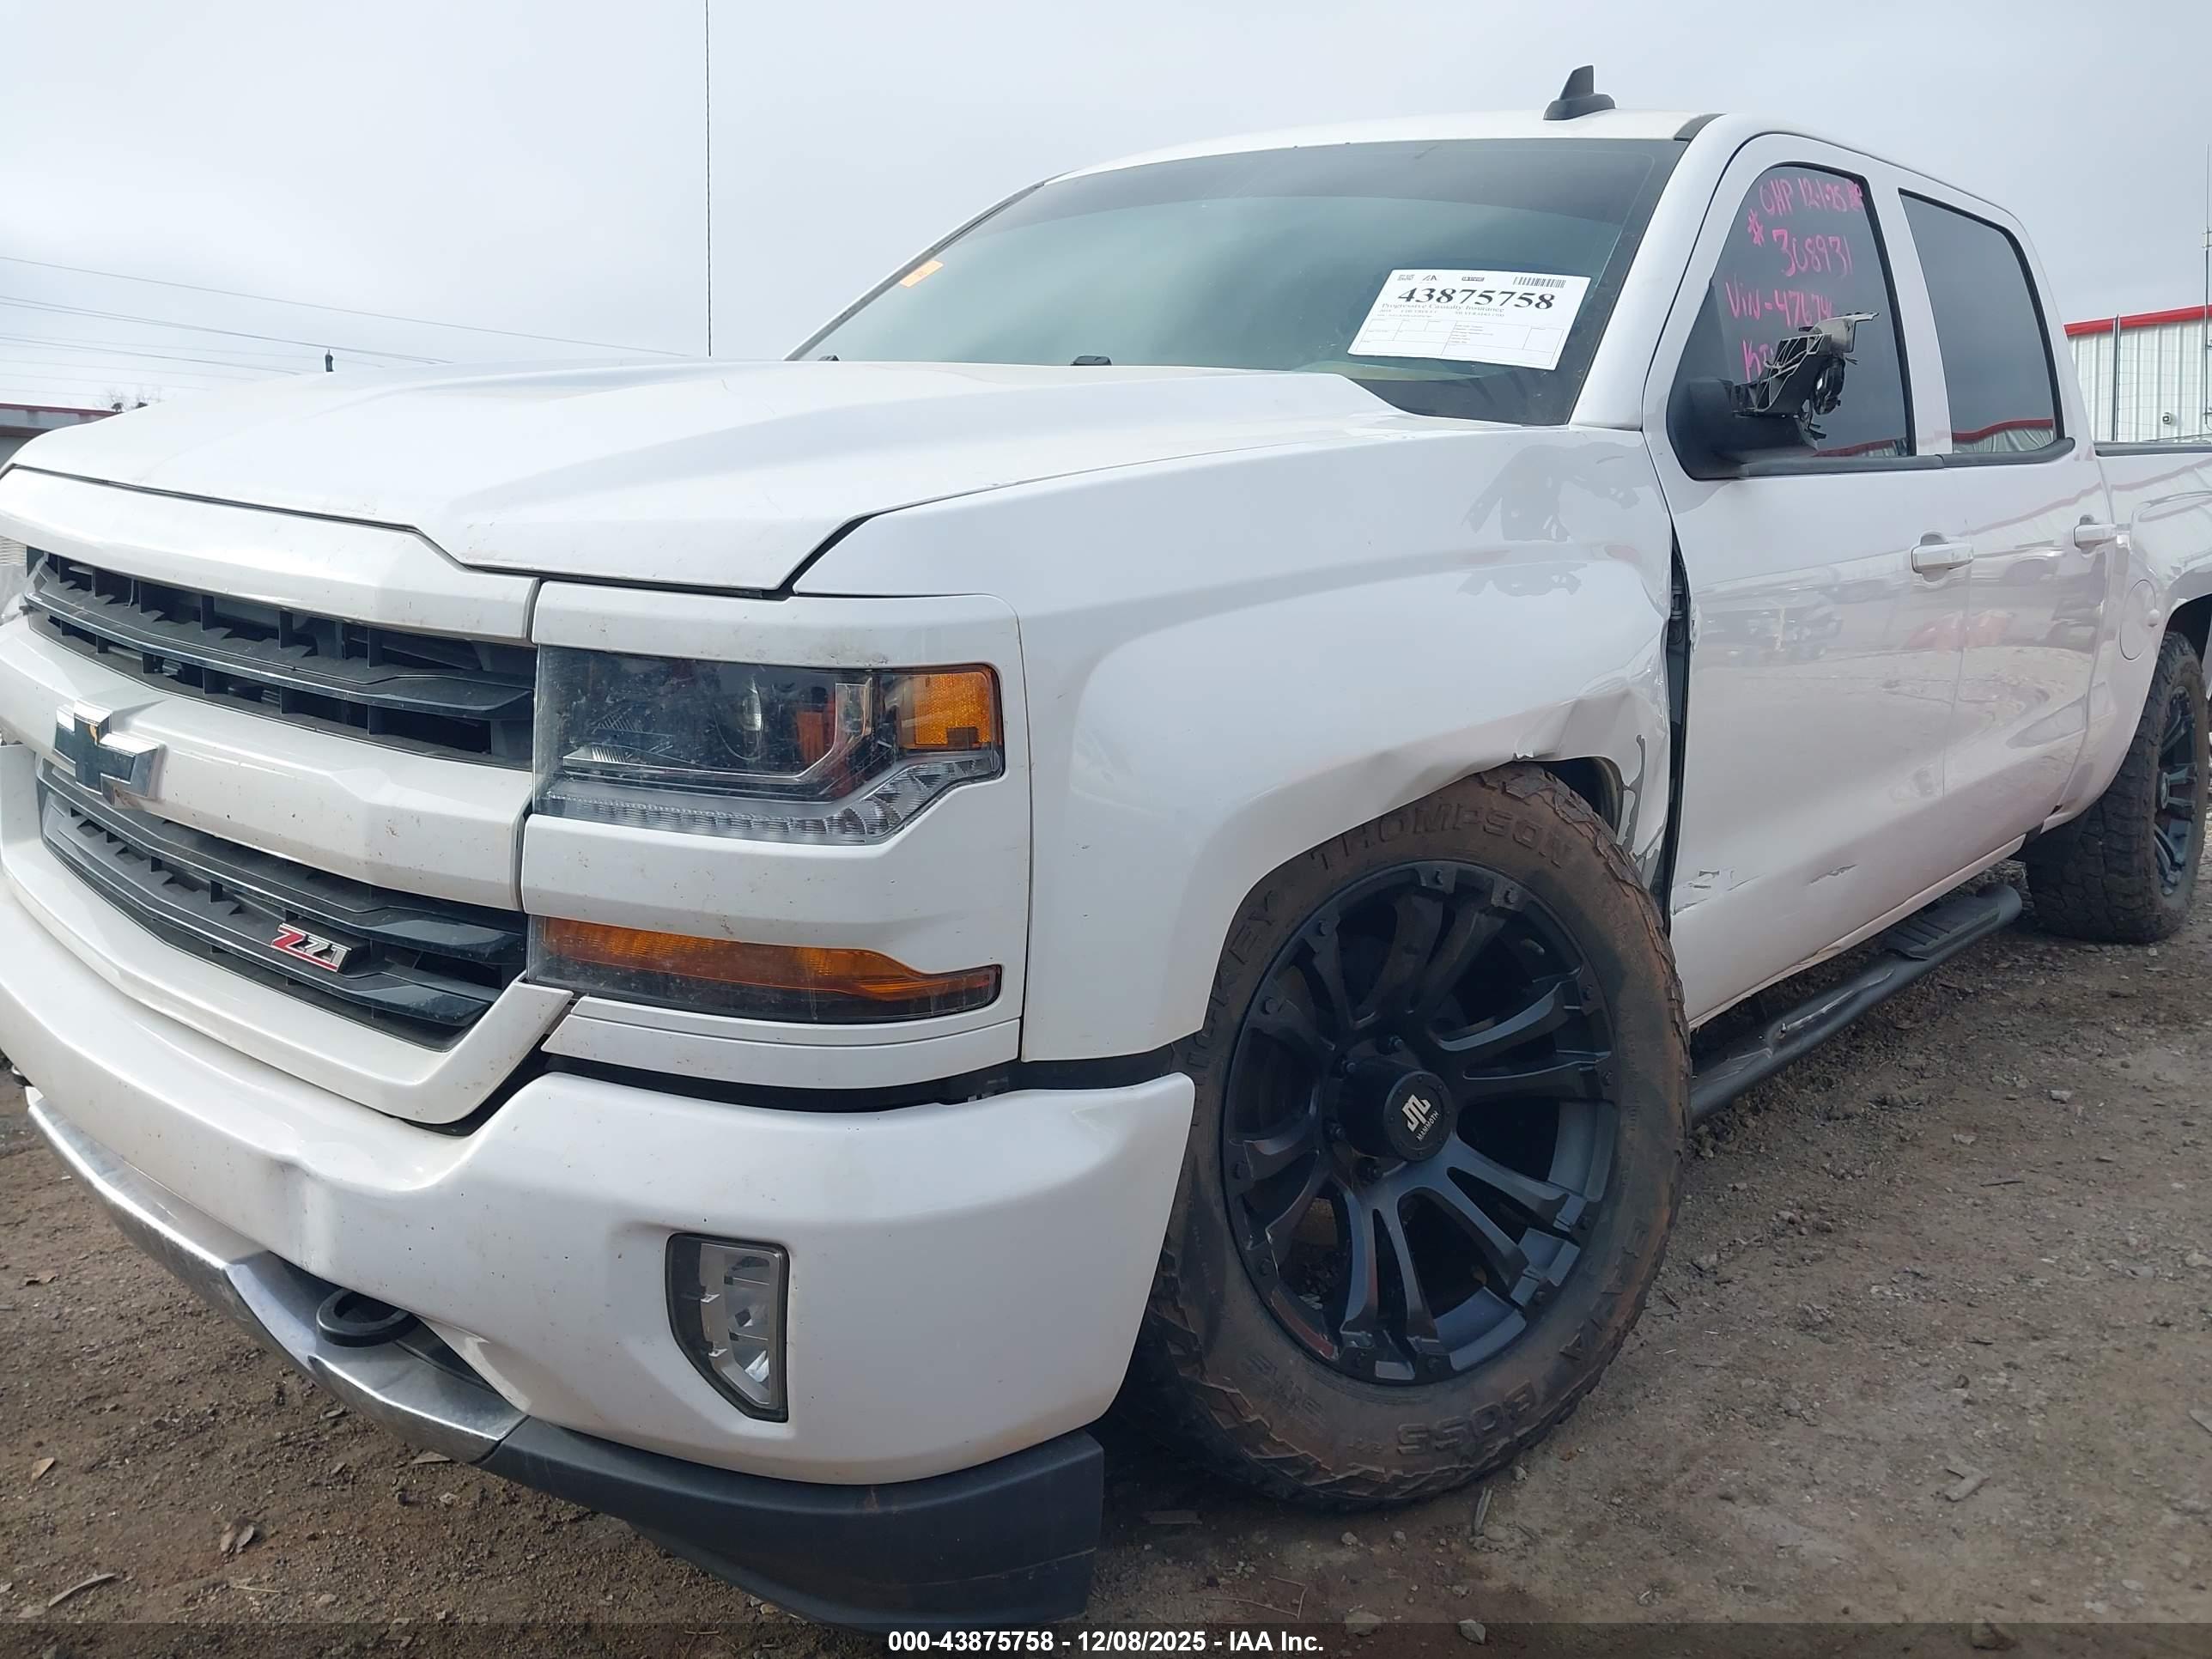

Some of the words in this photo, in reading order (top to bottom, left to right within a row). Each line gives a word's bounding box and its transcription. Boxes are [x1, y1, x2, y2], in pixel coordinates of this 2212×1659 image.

[1397, 287, 1556, 310] 43875758
[270, 922, 351, 972] Z71
[1396, 1377, 1535, 1456] BOSS
